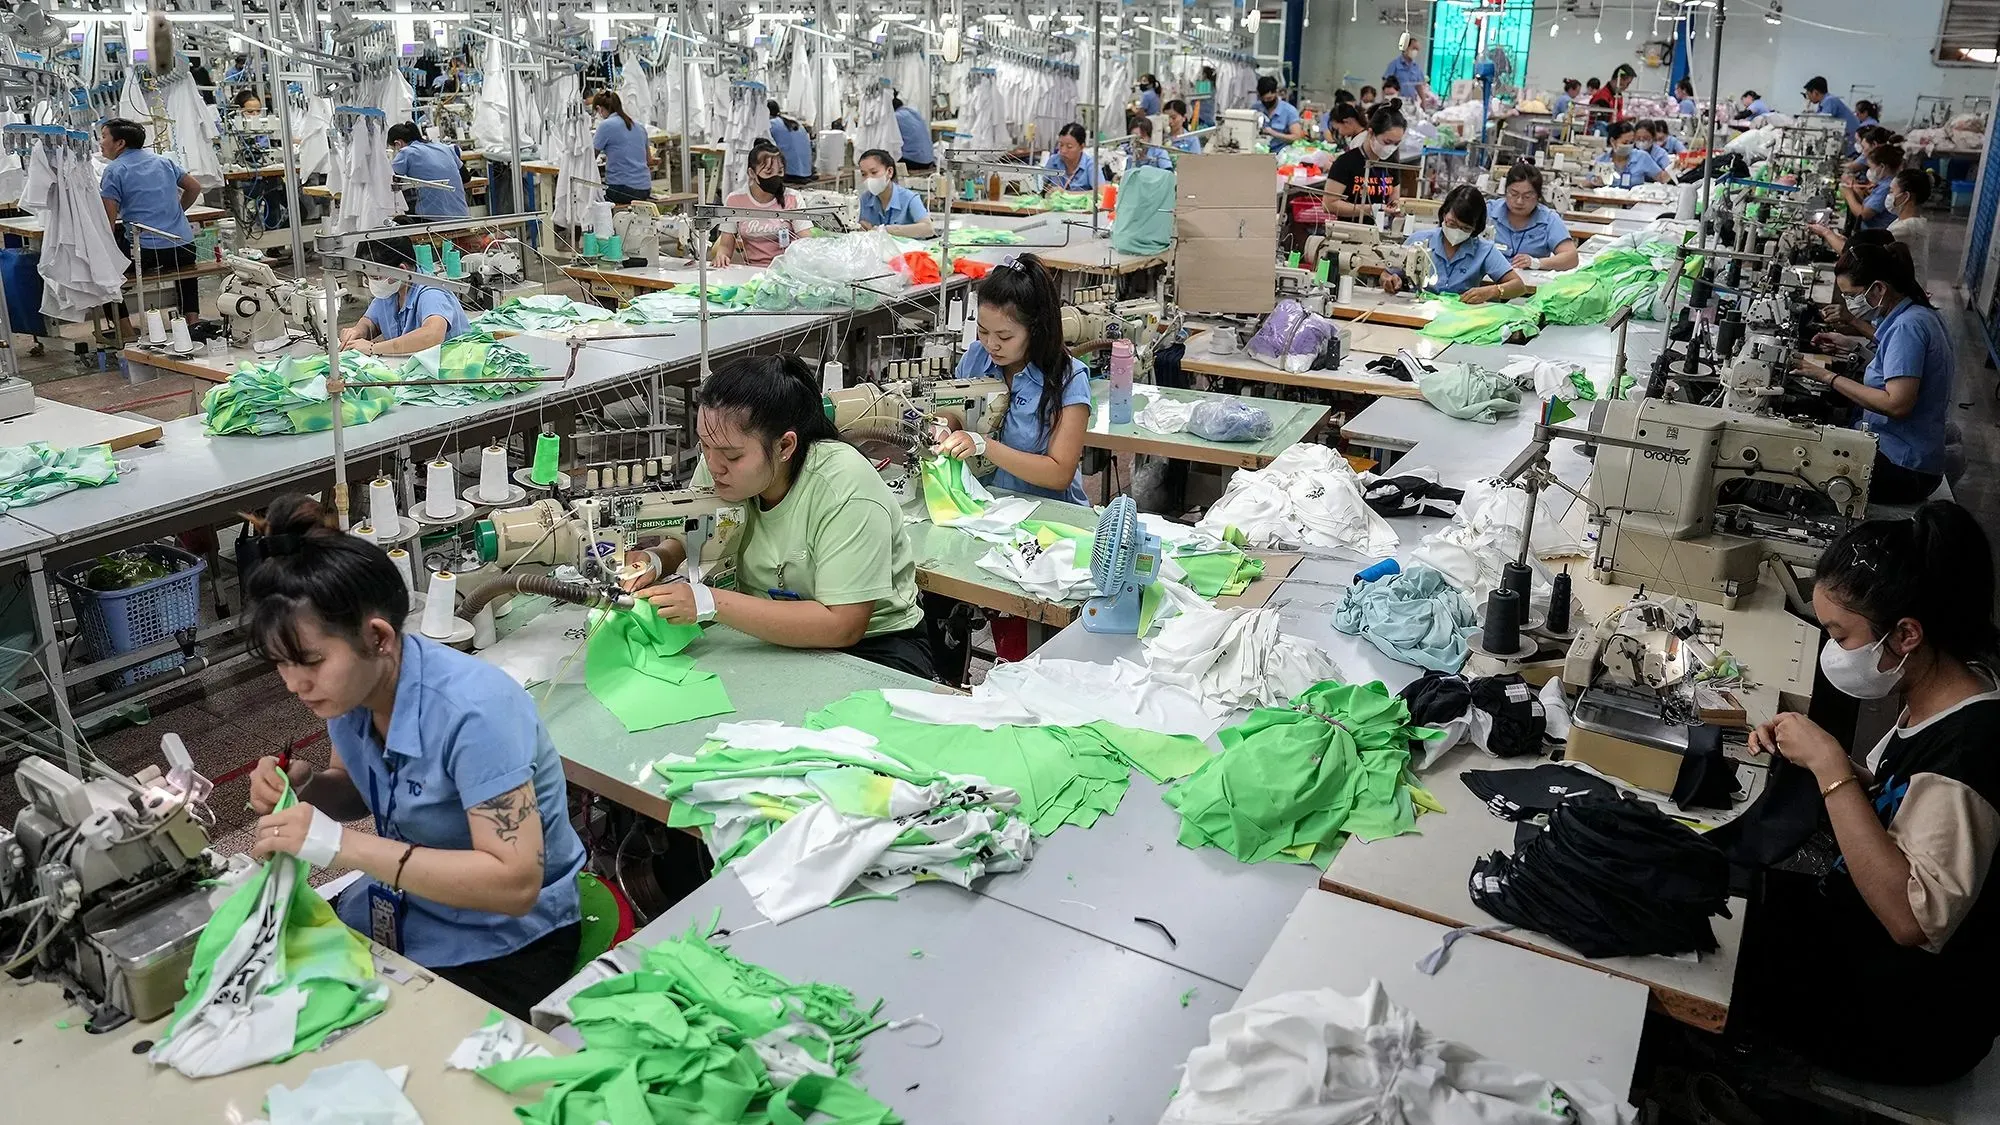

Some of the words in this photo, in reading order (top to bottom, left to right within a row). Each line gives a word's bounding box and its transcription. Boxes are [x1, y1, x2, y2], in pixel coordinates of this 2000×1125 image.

[1644, 449, 1691, 465] brother
[642, 520, 666, 528] SHING
[406, 779, 423, 797] TC
